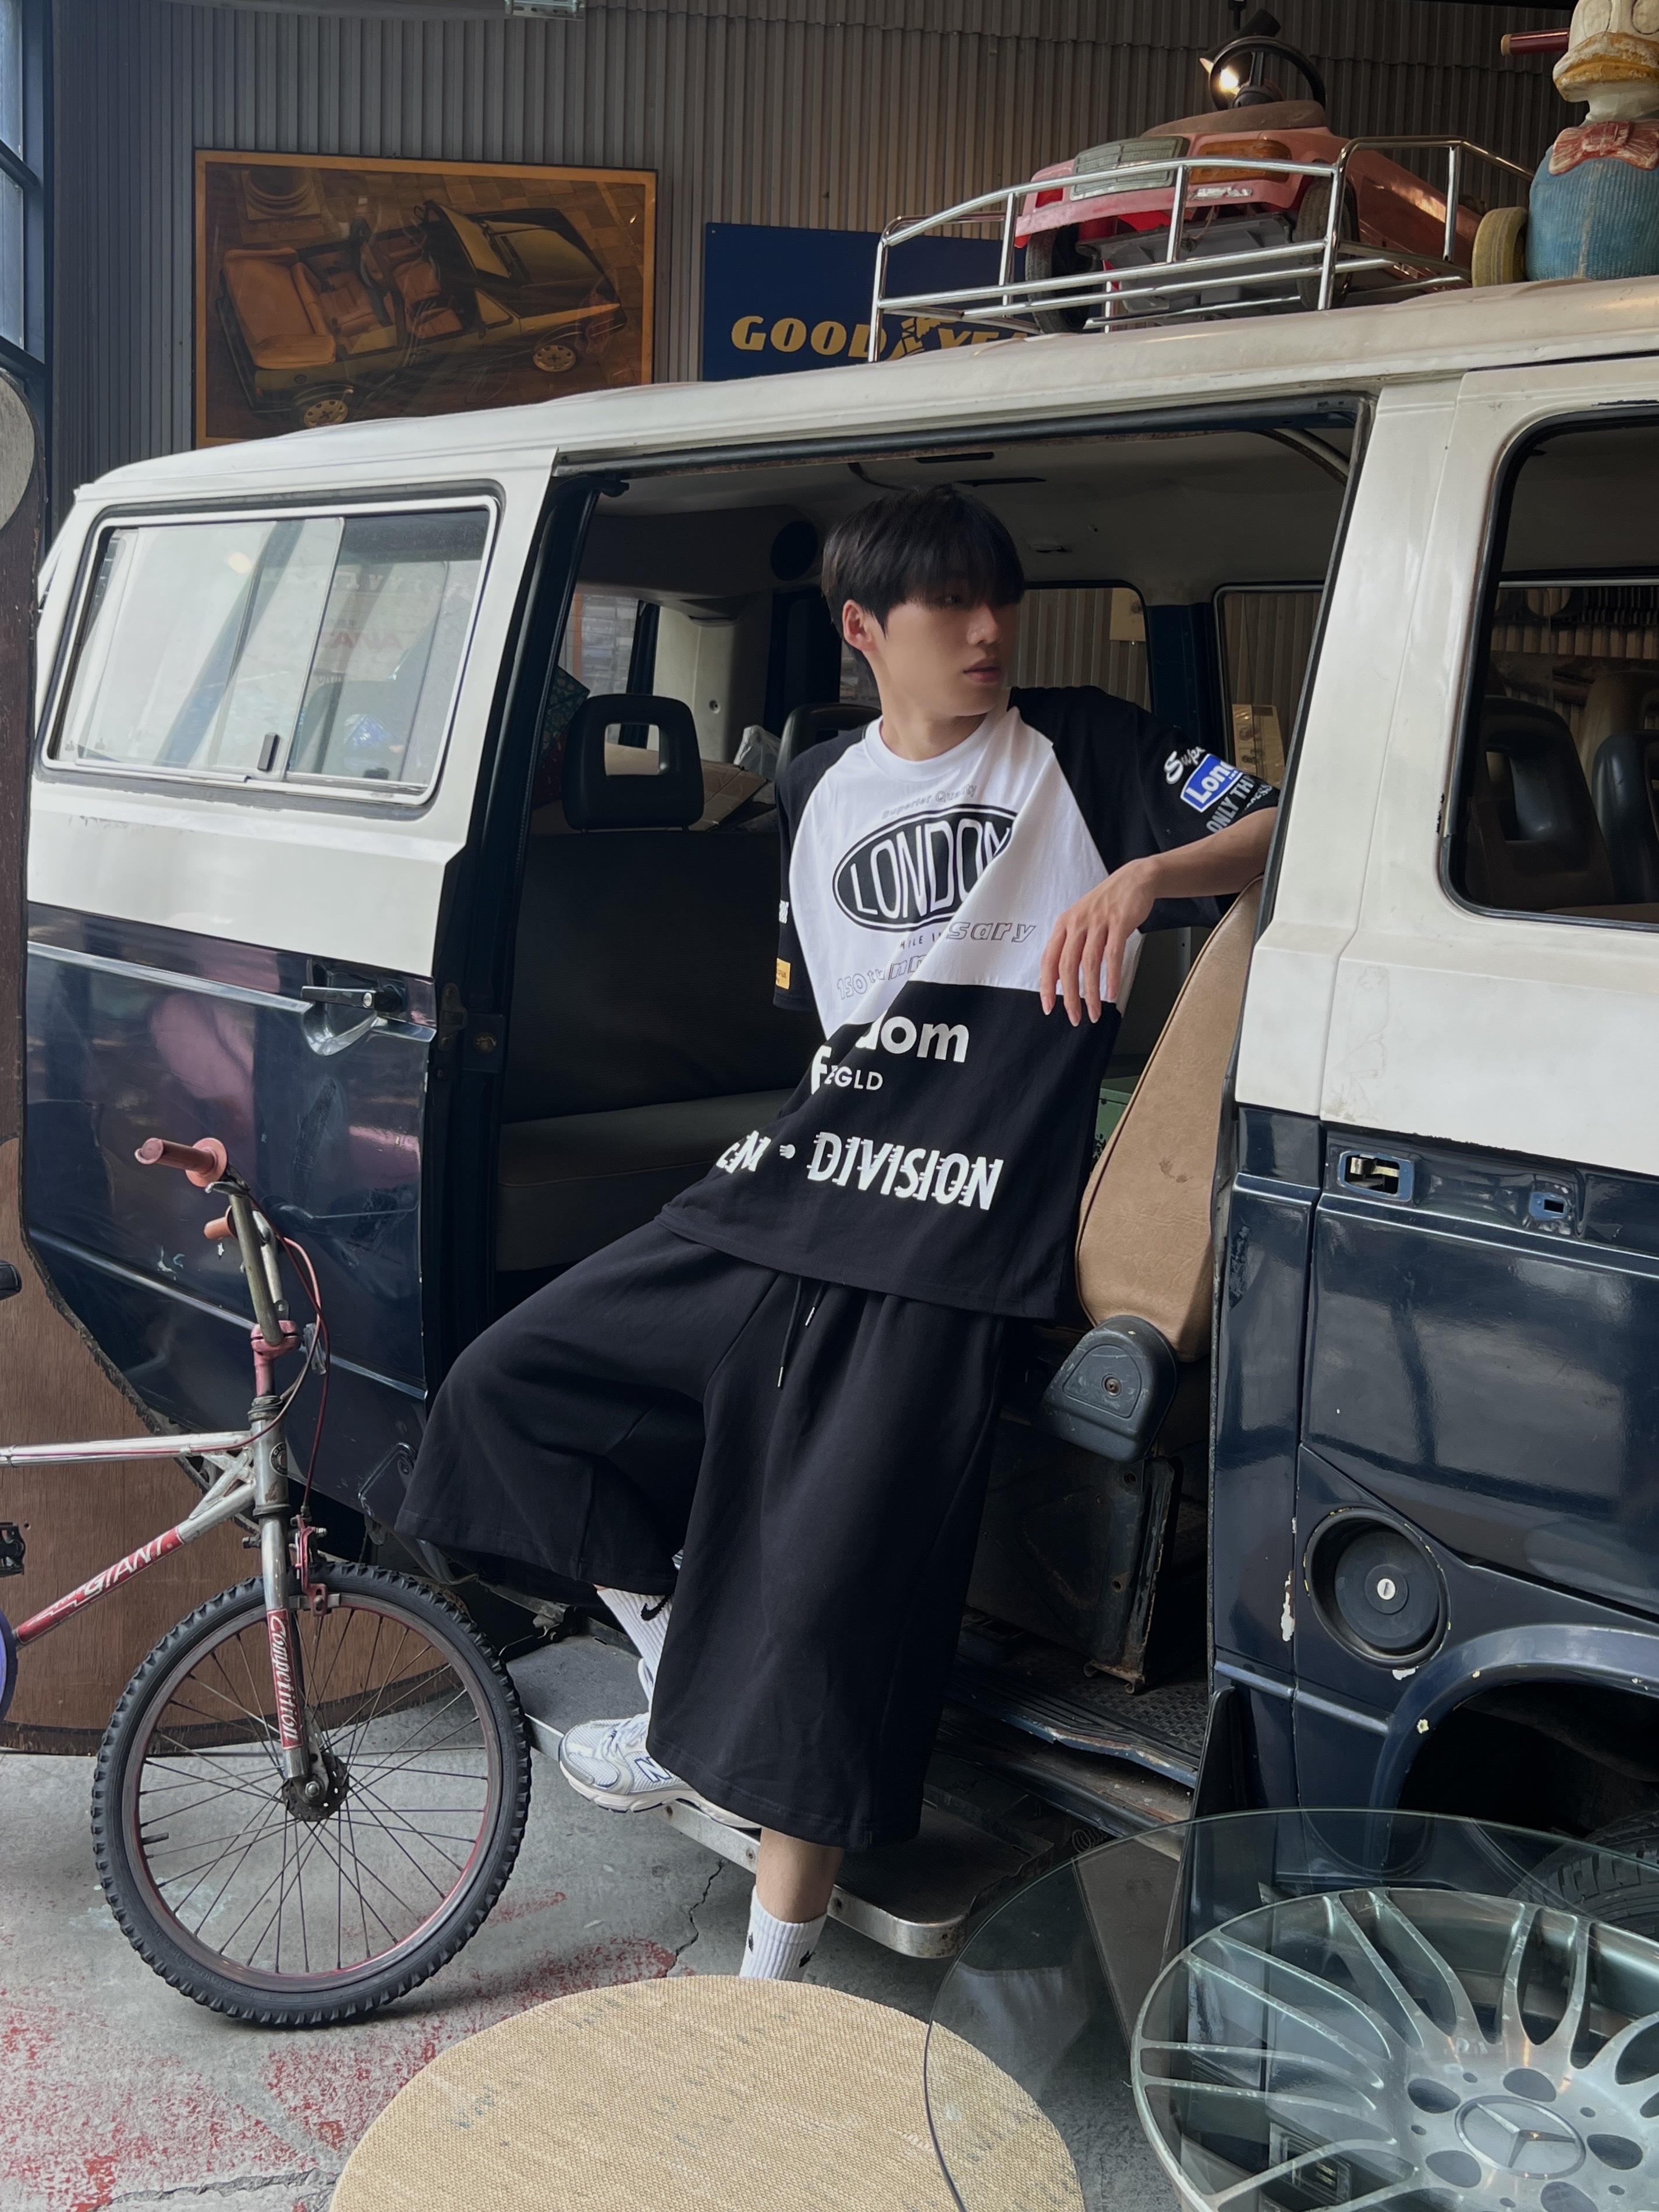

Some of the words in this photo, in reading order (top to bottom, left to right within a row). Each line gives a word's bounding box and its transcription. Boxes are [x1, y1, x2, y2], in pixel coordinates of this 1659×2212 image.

[1206, 796, 1239, 834] ONLY
[946, 921, 1036, 943] sary
[807, 1131, 1004, 1211] DIVISION
[84, 1531, 169, 1596] GIANT
[270, 1615, 299, 1741] Competition
